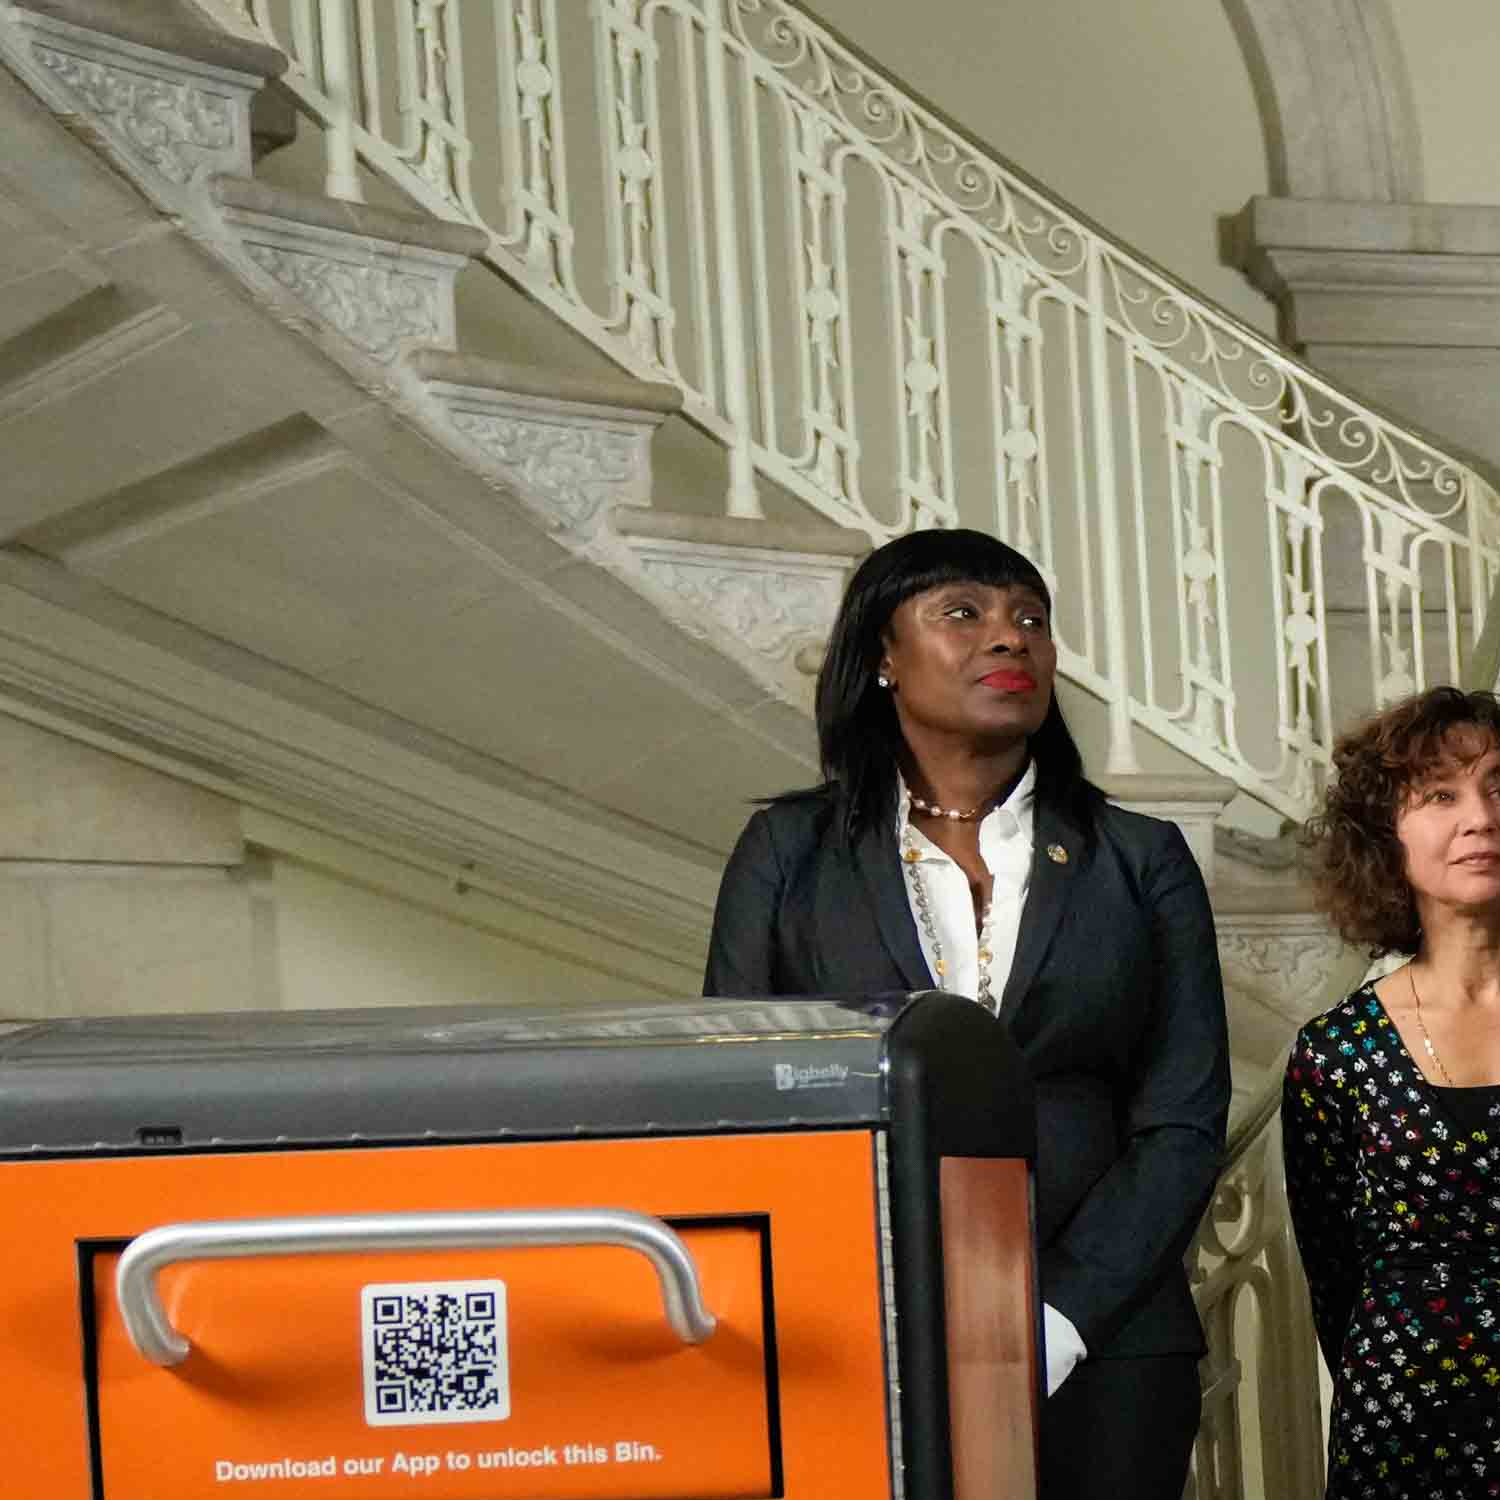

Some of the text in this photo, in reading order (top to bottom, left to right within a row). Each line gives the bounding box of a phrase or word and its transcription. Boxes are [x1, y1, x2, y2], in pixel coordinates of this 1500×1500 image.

[215, 1441, 662, 1482] Download our App to unlock this Bin.
